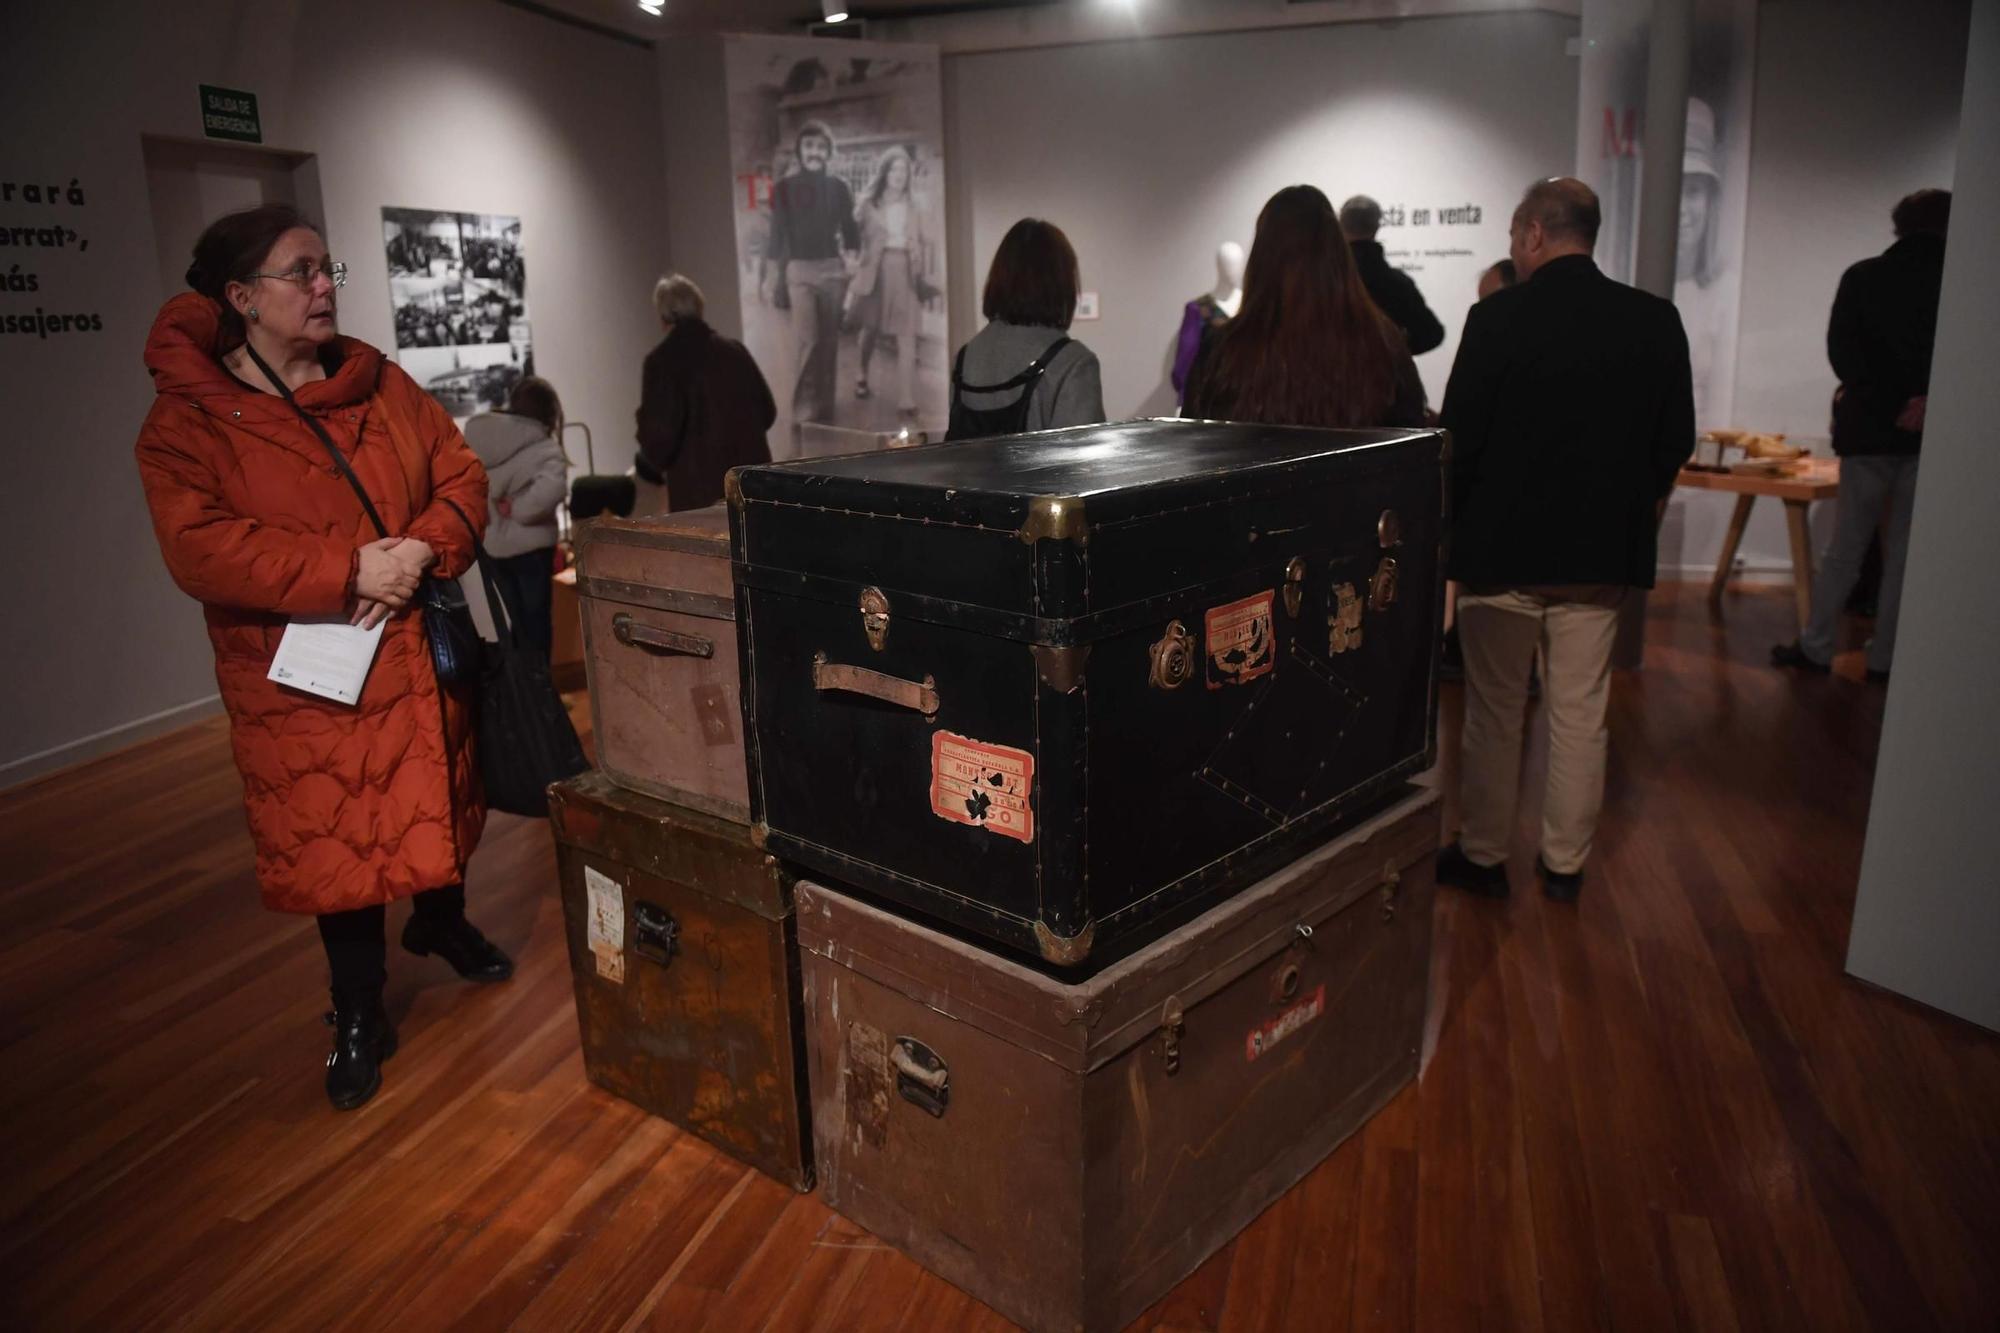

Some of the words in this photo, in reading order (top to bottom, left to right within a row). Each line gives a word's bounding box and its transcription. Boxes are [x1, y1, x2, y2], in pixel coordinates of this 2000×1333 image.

[208, 95, 239, 112] SALIDA
[239, 98, 252, 115] DE
[205, 114, 258, 134] EMERGENCIA
[1379, 203, 1405, 226] stá
[1413, 207, 1430, 226] en
[1439, 203, 1482, 225] venta
[0, 306, 103, 339] sajeros
